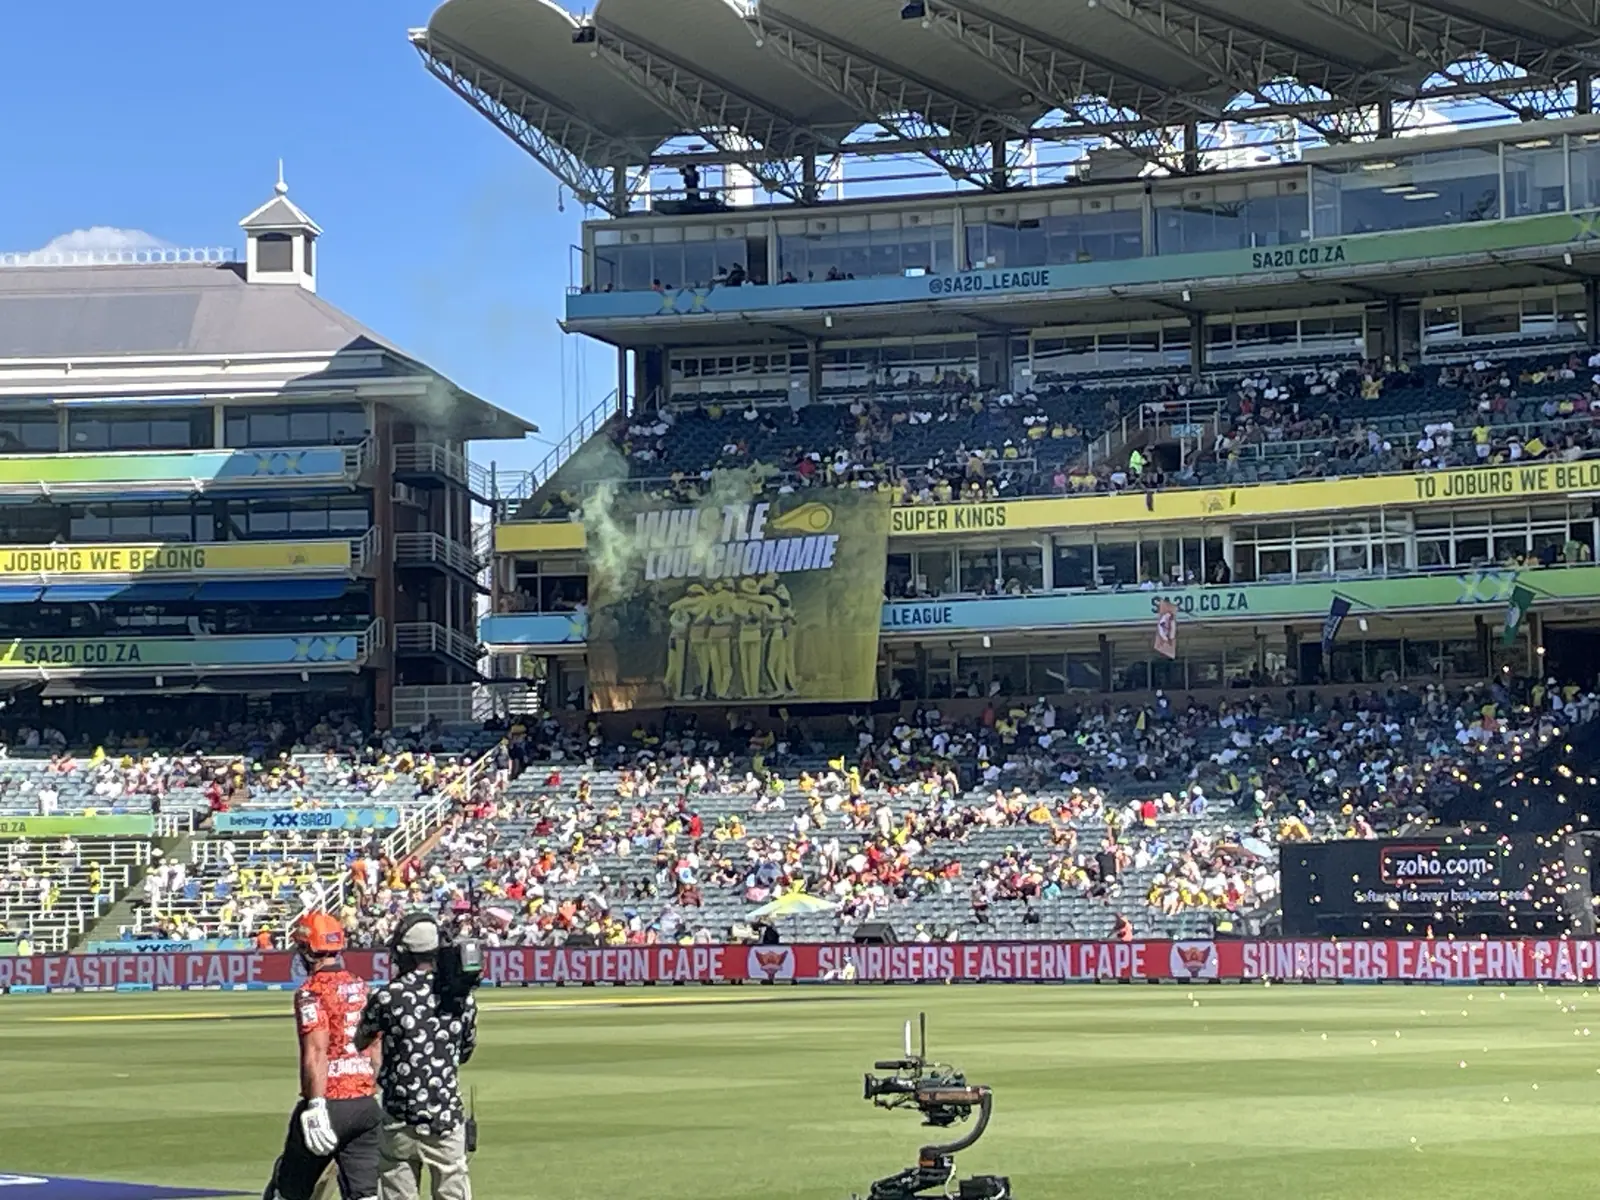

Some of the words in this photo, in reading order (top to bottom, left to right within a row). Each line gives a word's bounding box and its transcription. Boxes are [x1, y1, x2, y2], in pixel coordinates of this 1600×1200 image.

[1252, 244, 1345, 269] SA20.CO.ZA
[1415, 477, 1435, 499] TO
[1443, 471, 1513, 497] JOBURG
[1520, 468, 1549, 491] WE
[893, 509, 948, 532] SUPER
[954, 505, 1006, 529] KINGS
[4, 552, 82, 572] JOBURG
[90, 551, 121, 571] WE
[130, 549, 206, 570] BELONG
[1151, 592, 1248, 614] S20.CO.ZA
[24, 643, 141, 664] SA20.CO.ZA
[230, 815, 268, 828] betway
[1396, 854, 1488, 875] zoho.com
[44, 955, 176, 986] EASTERN
[186, 953, 264, 985] CAPE
[534, 949, 650, 981] EASTERN
[658, 946, 726, 980] CAPE
[818, 945, 954, 980] SUNRISERS
[963, 944, 1072, 979] EASTERN
[1080, 943, 1147, 978] CAPE
[1242, 941, 1389, 979] SUNRISERS
[1397, 940, 1524, 980] EASTERN
